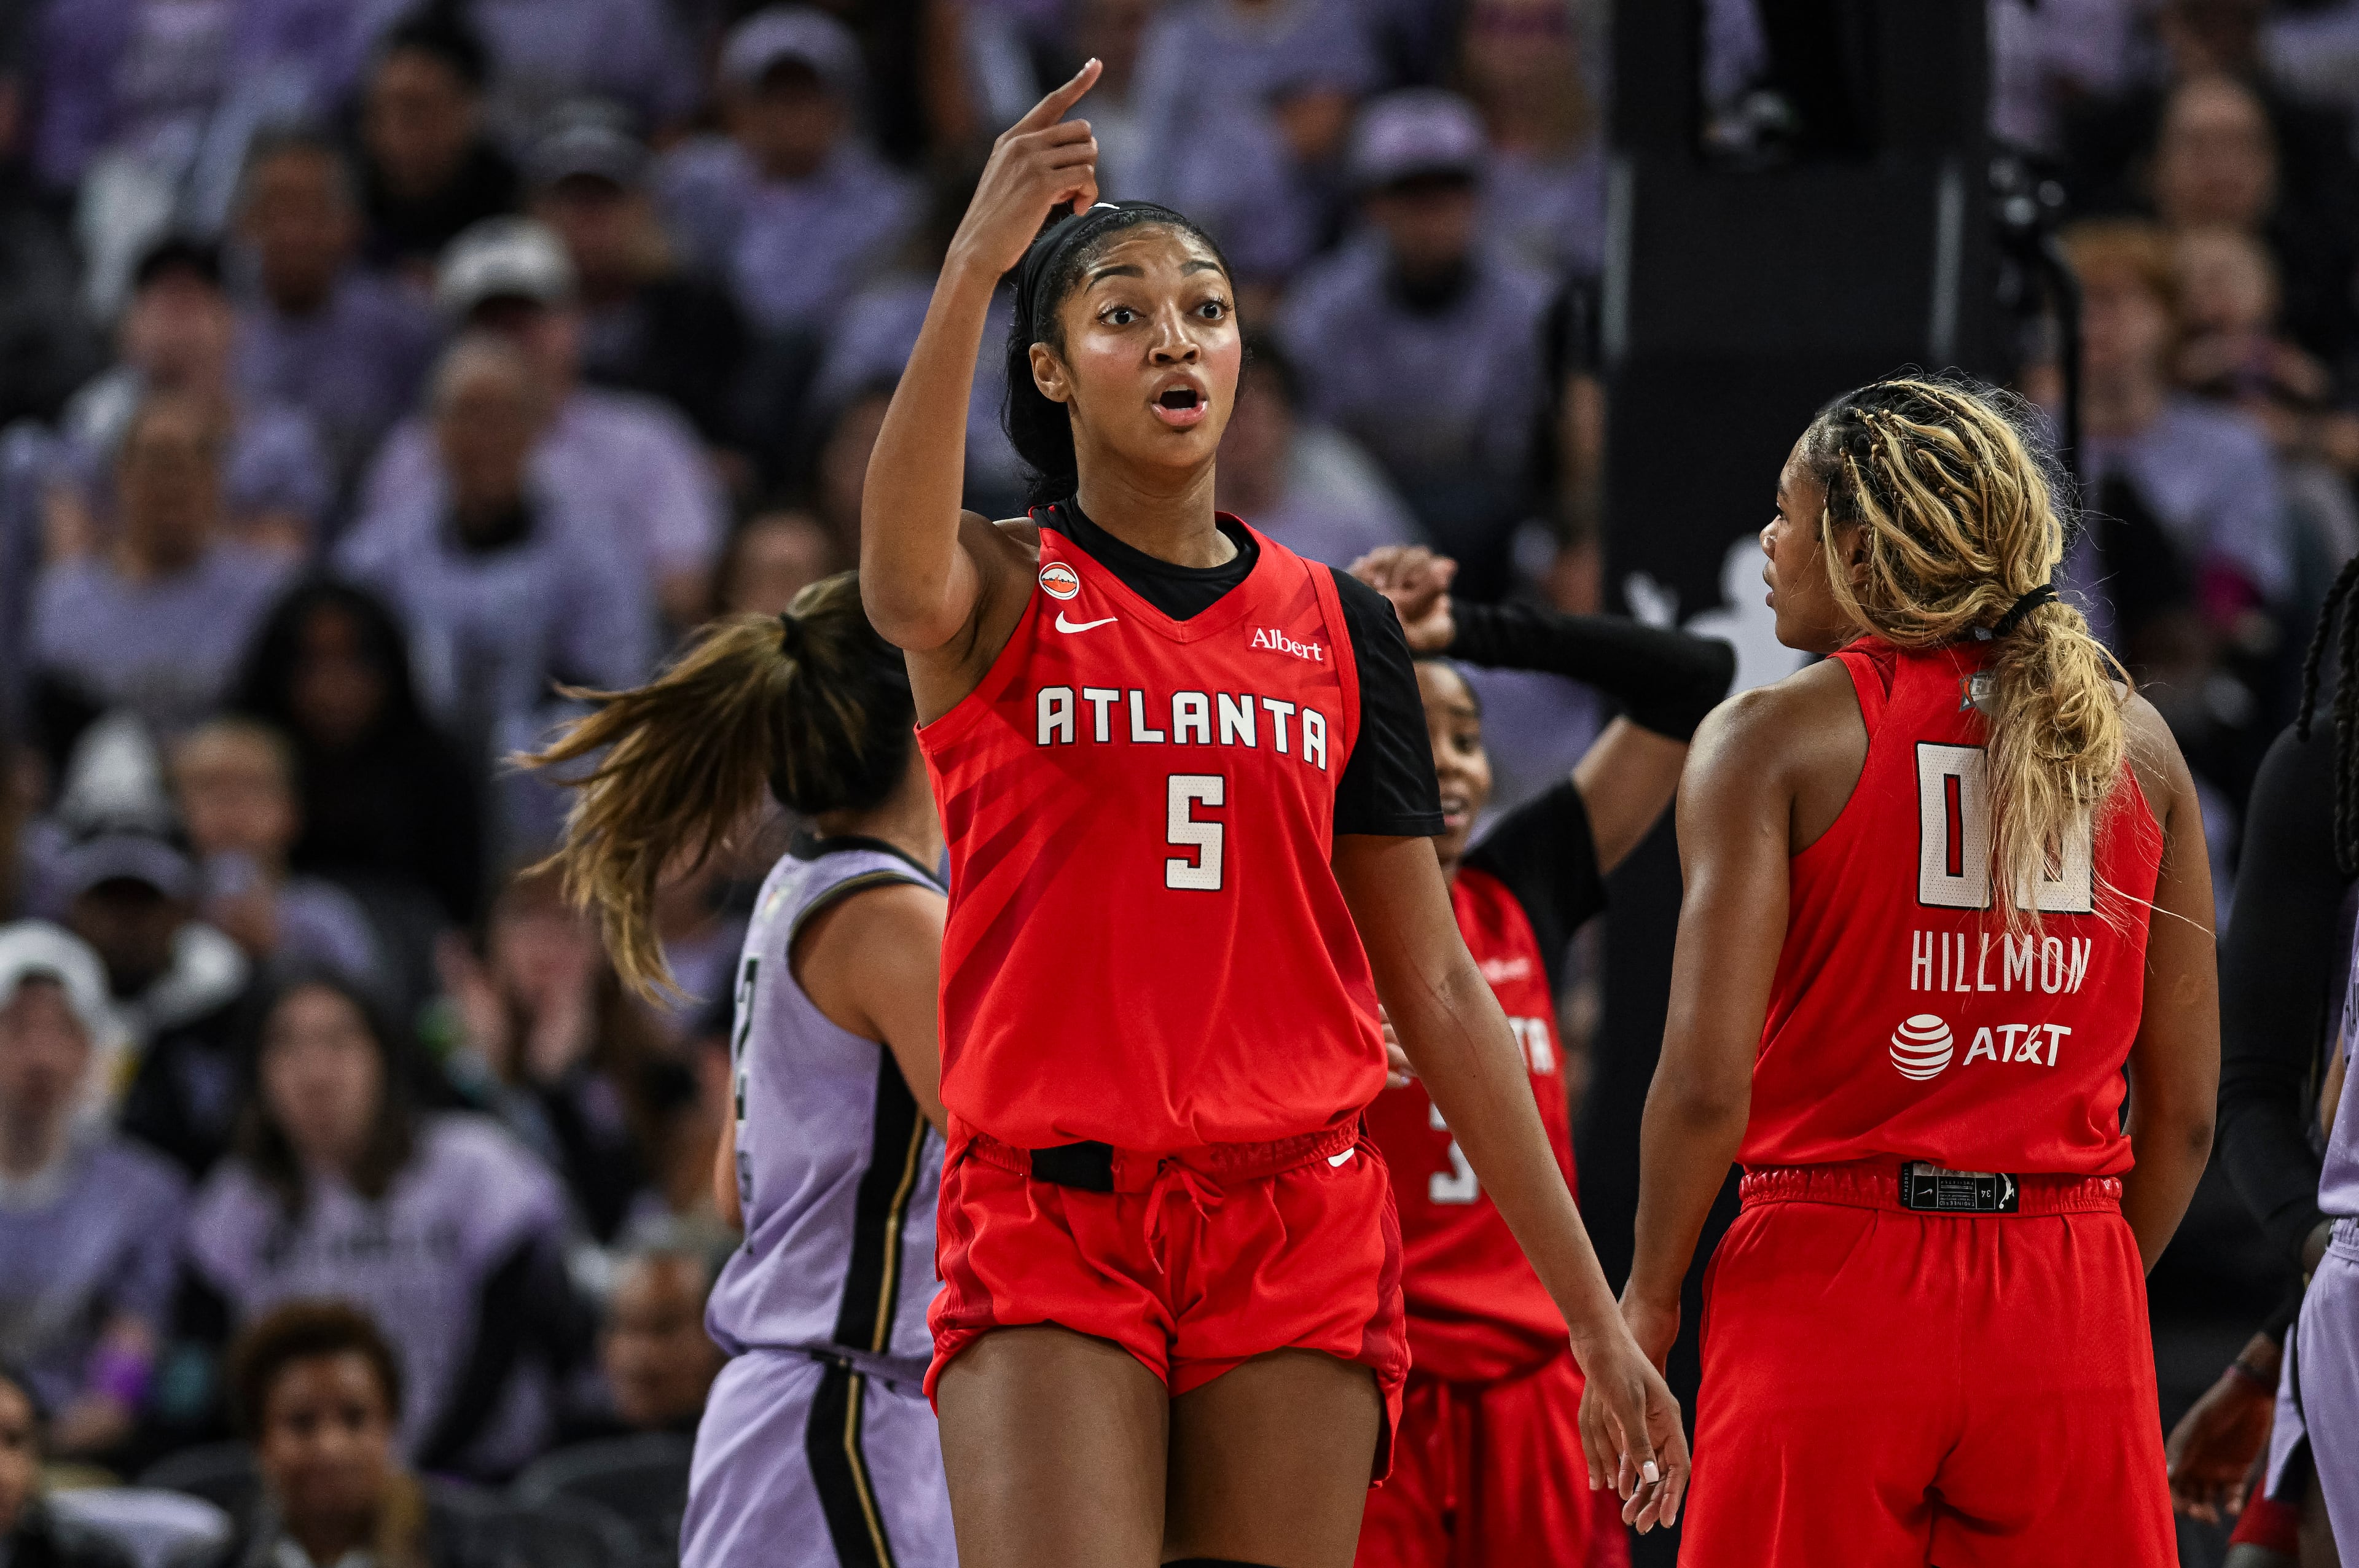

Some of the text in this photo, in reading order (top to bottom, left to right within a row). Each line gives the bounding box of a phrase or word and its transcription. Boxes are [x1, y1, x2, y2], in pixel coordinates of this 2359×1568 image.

[1250, 627, 1324, 663] Albert
[1036, 684, 1327, 772] ATLANTA
[1165, 773, 1224, 891] 5
[1911, 930, 2091, 994] HILLMON
[1963, 1023, 2071, 1067] AT&T
